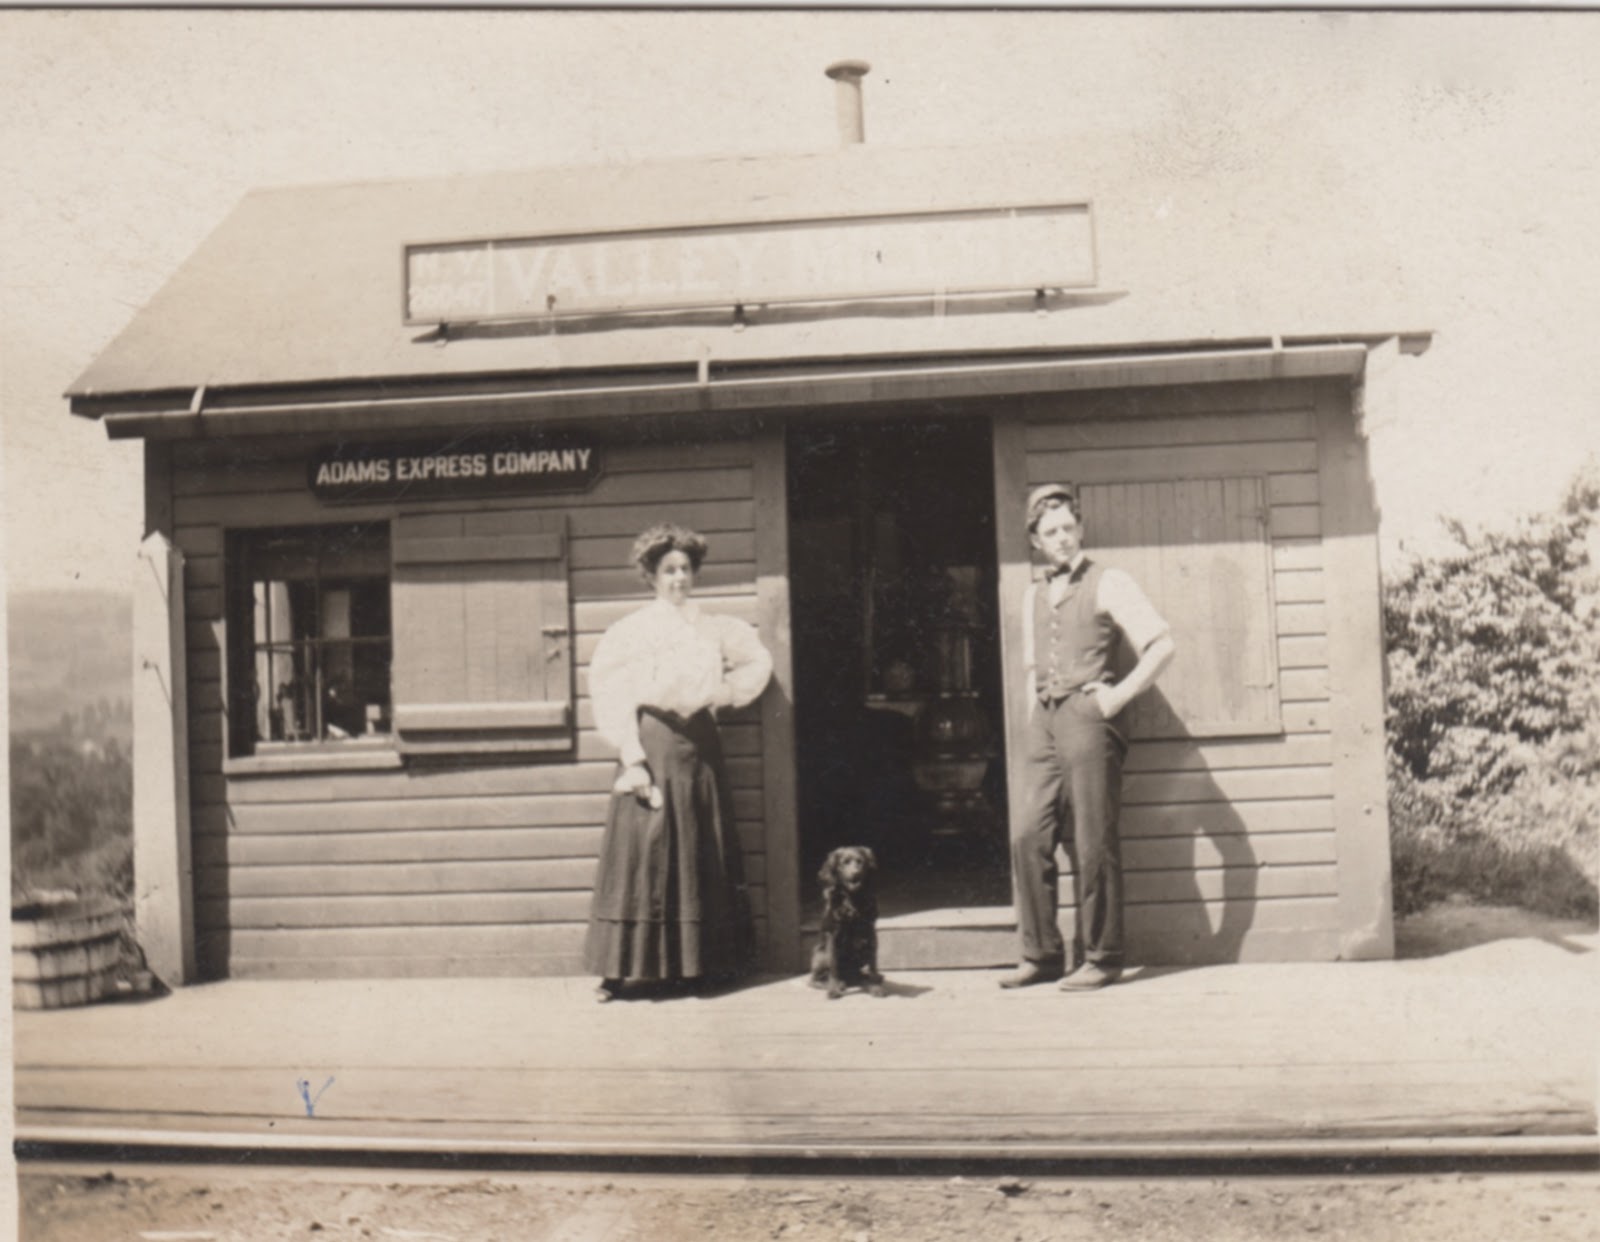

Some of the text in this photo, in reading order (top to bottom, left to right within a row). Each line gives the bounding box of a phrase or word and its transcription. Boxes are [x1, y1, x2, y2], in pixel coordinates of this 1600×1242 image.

[316, 448, 591, 485] ADAMS EXPRESS COMPANY
